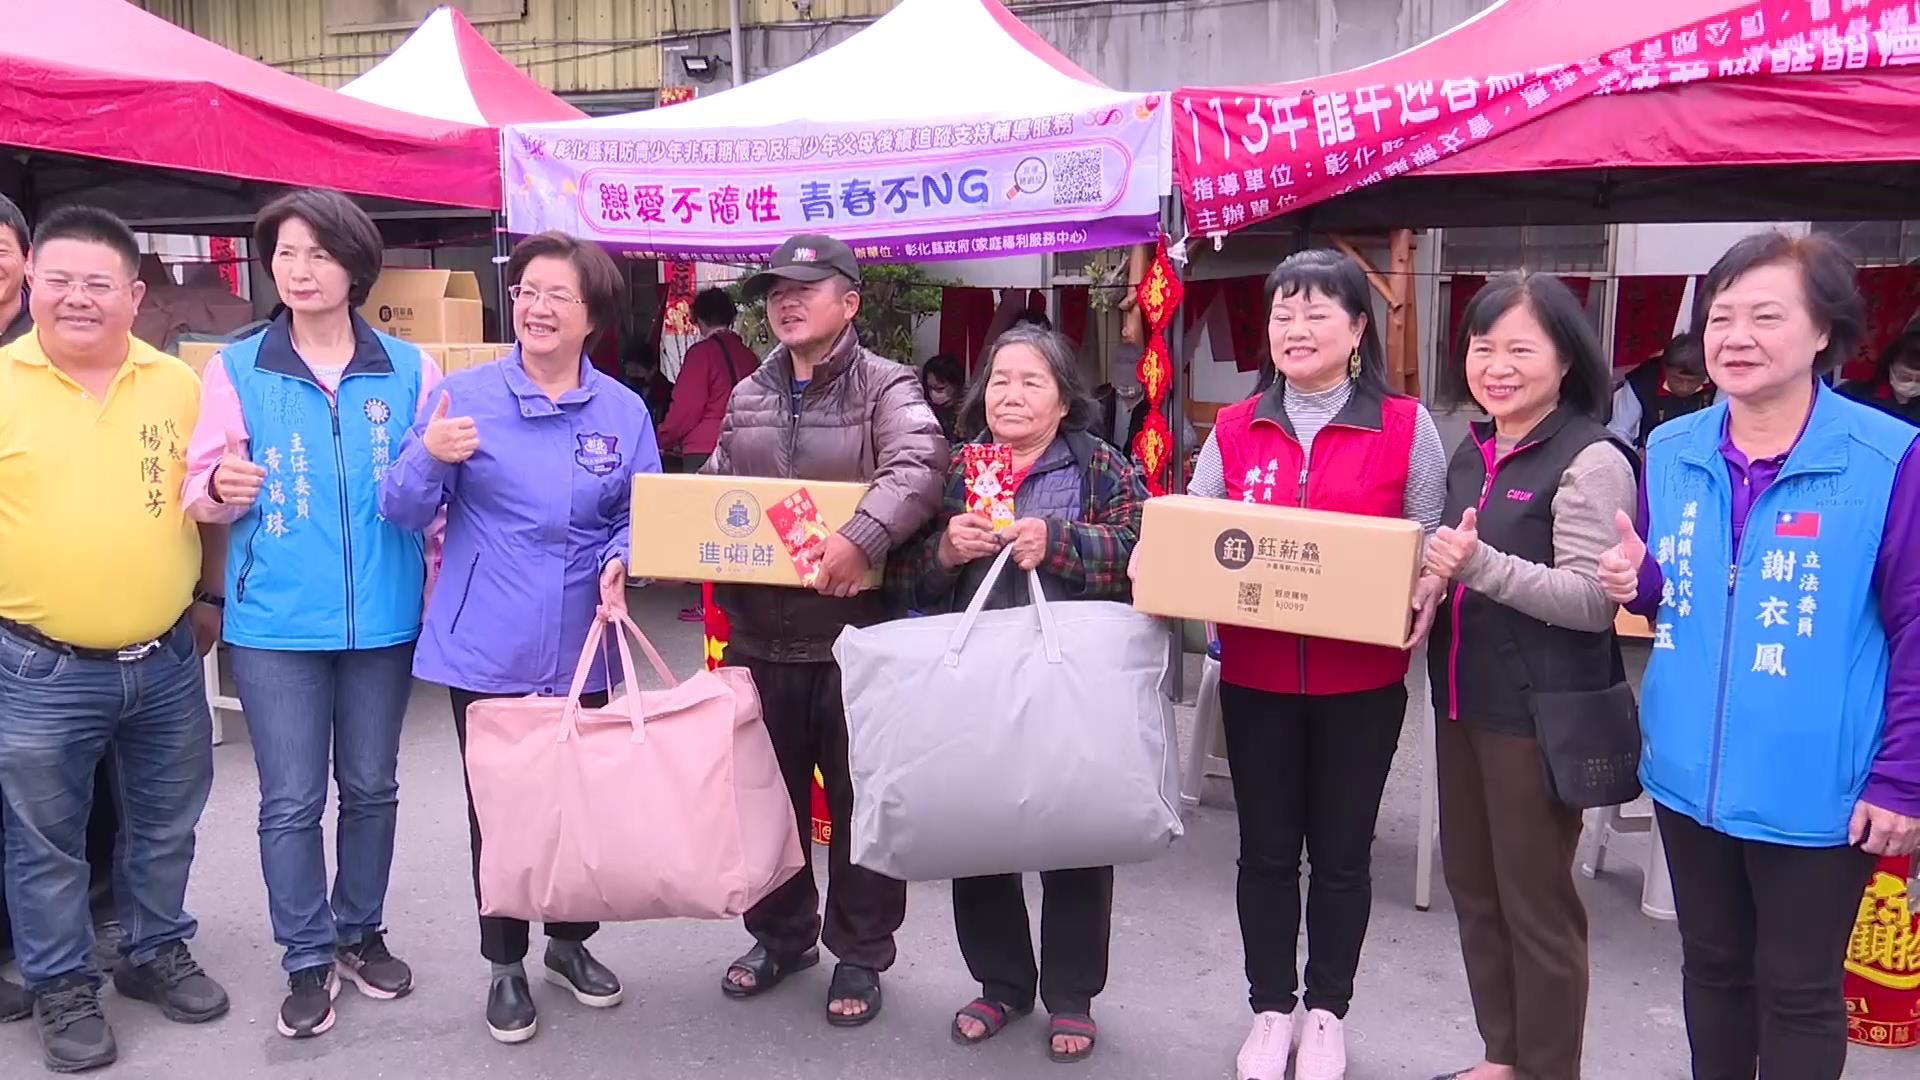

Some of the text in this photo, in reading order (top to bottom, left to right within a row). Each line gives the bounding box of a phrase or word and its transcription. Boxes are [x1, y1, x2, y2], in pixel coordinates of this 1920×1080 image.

[600, 182, 781, 224] 戀愛不隨性
[800, 169, 989, 221] 青春不NG
[140, 424, 166, 518] 楊隆芳
[291, 432, 311, 519] 主任委員
[699, 542, 774, 567] 進嗨鮮
[1223, 537, 1248, 563] 鈺
[1678, 501, 1697, 617] 溪湖鎮民代表
[1752, 550, 1797, 677] 謝衣鳳
[1796, 551, 1822, 638] 立法委員
